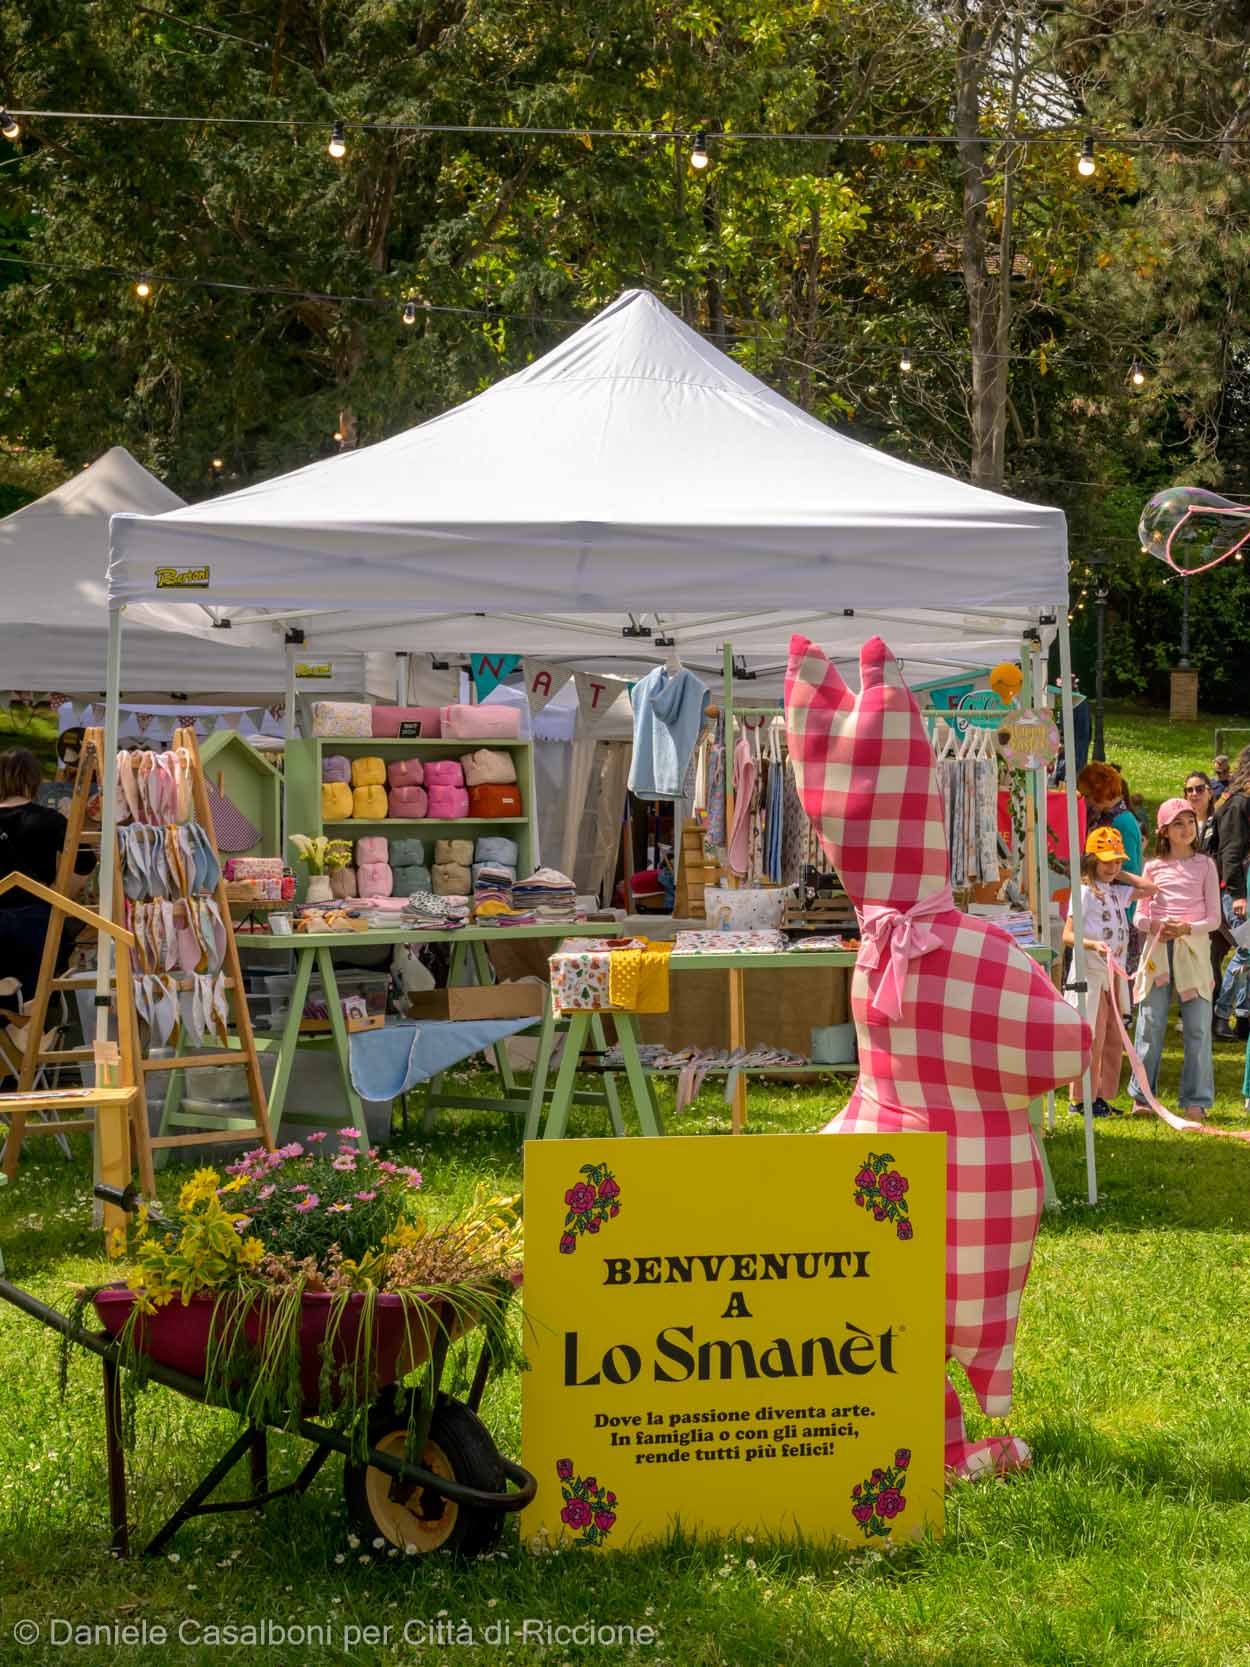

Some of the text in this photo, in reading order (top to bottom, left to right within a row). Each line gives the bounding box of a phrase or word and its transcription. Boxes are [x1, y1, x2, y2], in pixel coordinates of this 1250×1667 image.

[603, 1251, 871, 1286] BENVENUTI
[720, 1291, 753, 1319] A
[564, 1321, 899, 1387] Lo Smanèt
[594, 1404, 876, 1428] Dove la passione diventa arte.
[611, 1424, 860, 1447] In famiglia o con gli amici,
[635, 1442, 834, 1465] rende tutti più felici!
